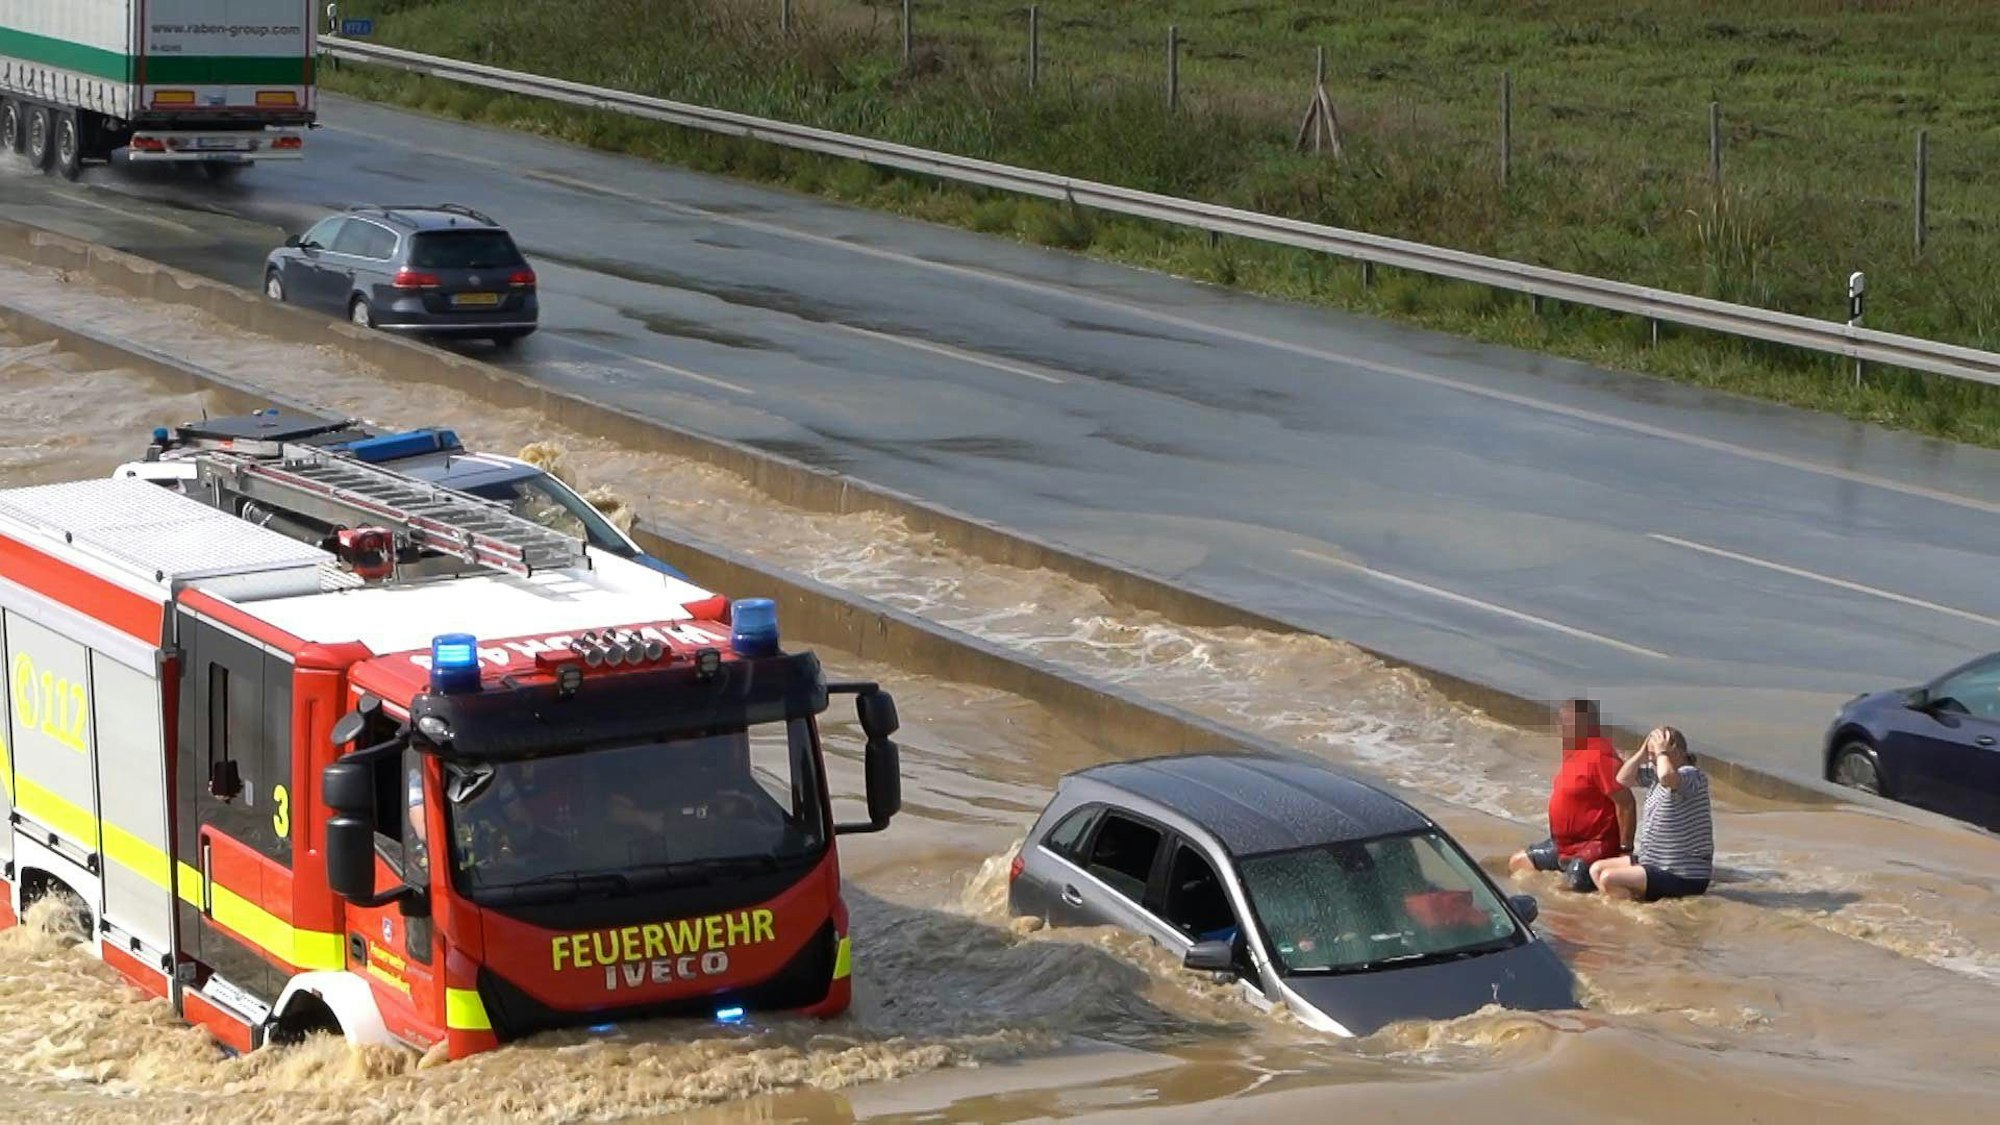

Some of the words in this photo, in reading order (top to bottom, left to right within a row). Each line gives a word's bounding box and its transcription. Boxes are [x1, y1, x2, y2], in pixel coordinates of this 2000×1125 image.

[151, 22, 300, 37] www.raben-group.com
[42, 670, 87, 752] 112
[273, 784, 289, 838] 3
[552, 908, 775, 971] FEUERWEHR
[605, 951, 728, 990] IVECO
